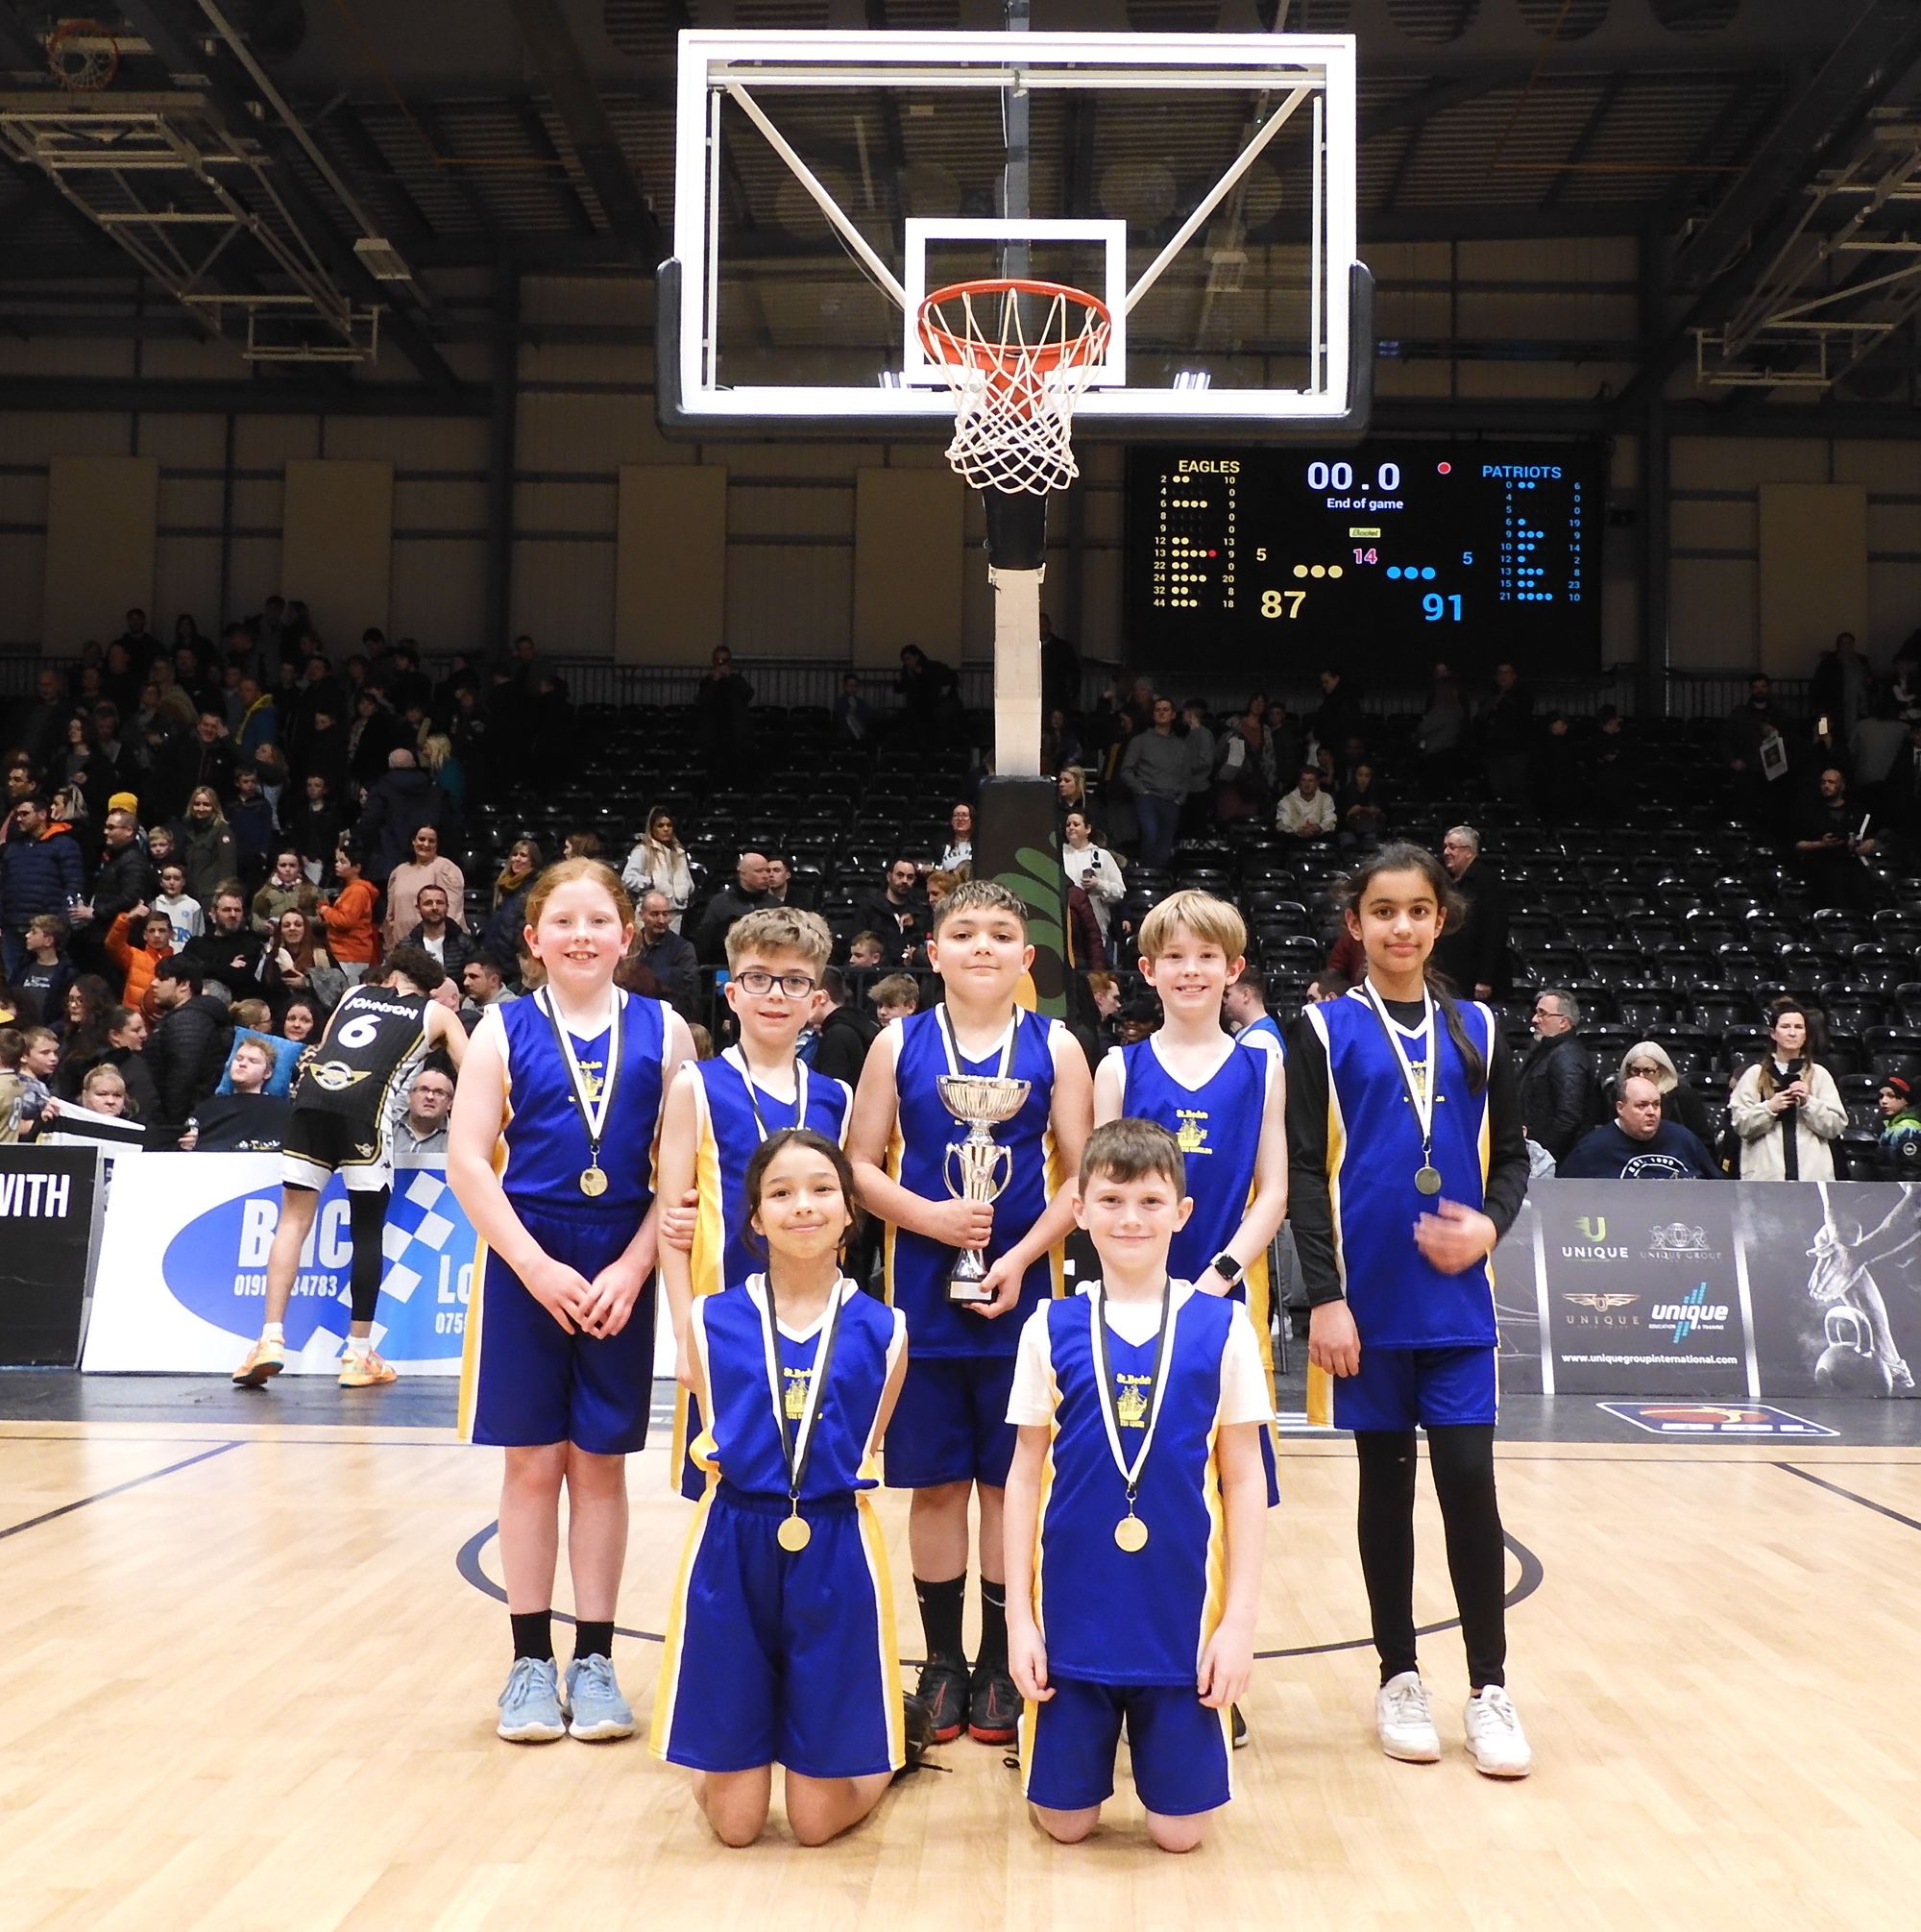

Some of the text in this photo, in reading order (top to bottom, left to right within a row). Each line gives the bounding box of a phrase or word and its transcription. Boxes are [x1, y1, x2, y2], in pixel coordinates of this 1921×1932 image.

[1179, 459, 1241, 474] EAGLES
[1482, 465, 1562, 478] PATRIOTS
[1160, 475, 1236, 485] 2 10
[1505, 480, 1581, 491] 0 6
[1160, 486, 1236, 497] 4 0
[1505, 493, 1581, 503] 4 0
[1159, 499, 1236, 509] 6 9
[1326, 498, 1404, 512] End of game
[1505, 505, 1581, 515] 5 0
[1228, 512, 1236, 522] 0
[1505, 517, 1581, 527] 6 19
[1159, 524, 1235, 534] 9 0
[1505, 529, 1581, 540] 9 9
[1155, 536, 1235, 547] 12 13
[1500, 542, 1581, 552] 10 14
[1155, 549, 1235, 559] 13 9
[1255, 548, 1267, 561] 5
[1352, 548, 1378, 565] 14
[1462, 551, 1473, 565] 5
[1500, 554, 1581, 565] 12 2
[1153, 561, 1235, 572] 22 0
[1500, 567, 1513, 576] 13
[1153, 573, 1235, 583] 24 20
[1153, 585, 1166, 595] 32
[1500, 579, 1581, 590] 15 23
[1499, 591, 1581, 602] 21 10
[1153, 598, 1234, 608] 44 18
[1260, 590, 1306, 619] 87
[1422, 593, 1462, 621] 91
[344, 997, 419, 1020] JOHNSON
[337, 1014, 382, 1049] 6
[238, 1199, 353, 1269] BC
[1561, 1246, 1630, 1259] UNIQUE
[1639, 1251, 1722, 1260] UNIQUE GROUP
[435, 1312, 468, 1334] 075
[1566, 1315, 1641, 1326] UNIQUE
[1651, 1304, 1729, 1331] unique
[1561, 1354, 1739, 1365] www.uniquegroupinternational.com
